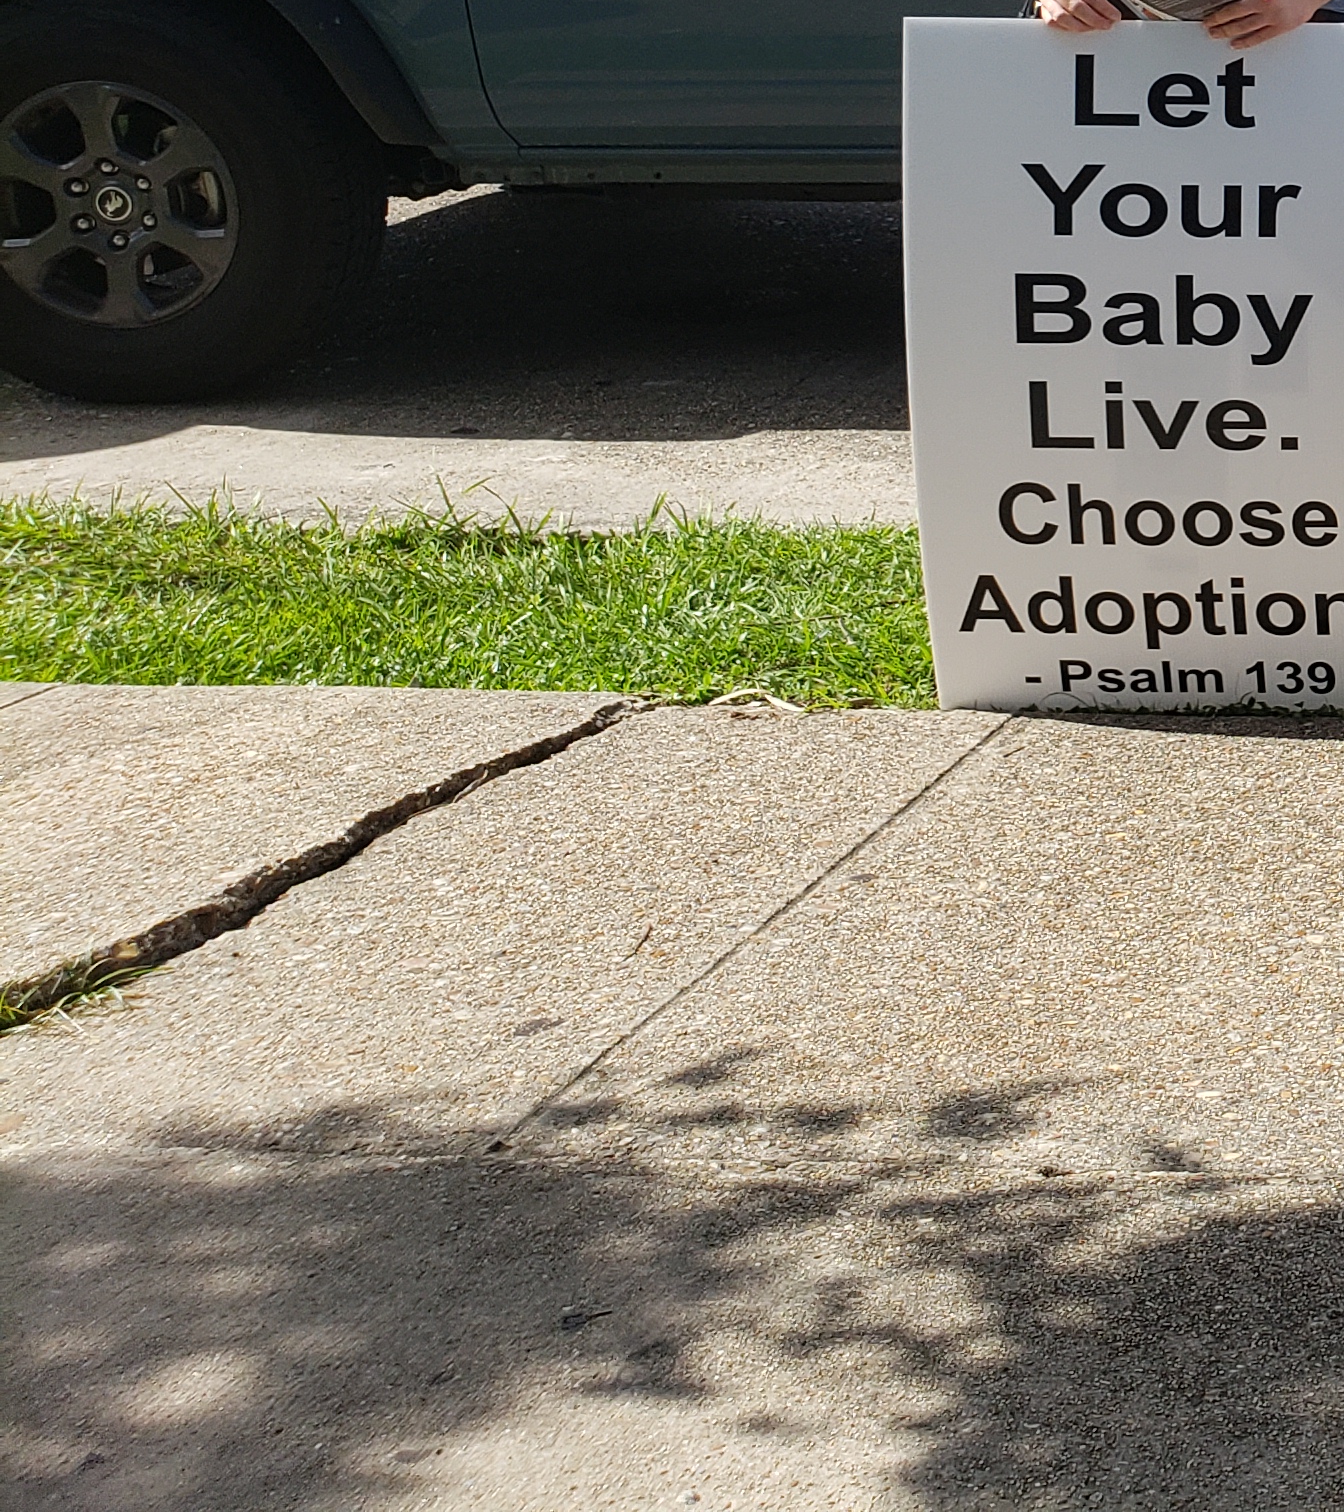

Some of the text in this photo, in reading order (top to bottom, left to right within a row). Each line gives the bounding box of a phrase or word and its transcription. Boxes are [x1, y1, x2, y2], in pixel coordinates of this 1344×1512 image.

[1075, 54, 1255, 128] Let
[1021, 164, 1301, 238] Your
[1015, 274, 1313, 365] Baby
[1029, 381, 1298, 450] Live.
[999, 482, 1338, 547] Choose
[1060, 660, 1224, 694] Psalm
[1246, 661, 1335, 694] 139
